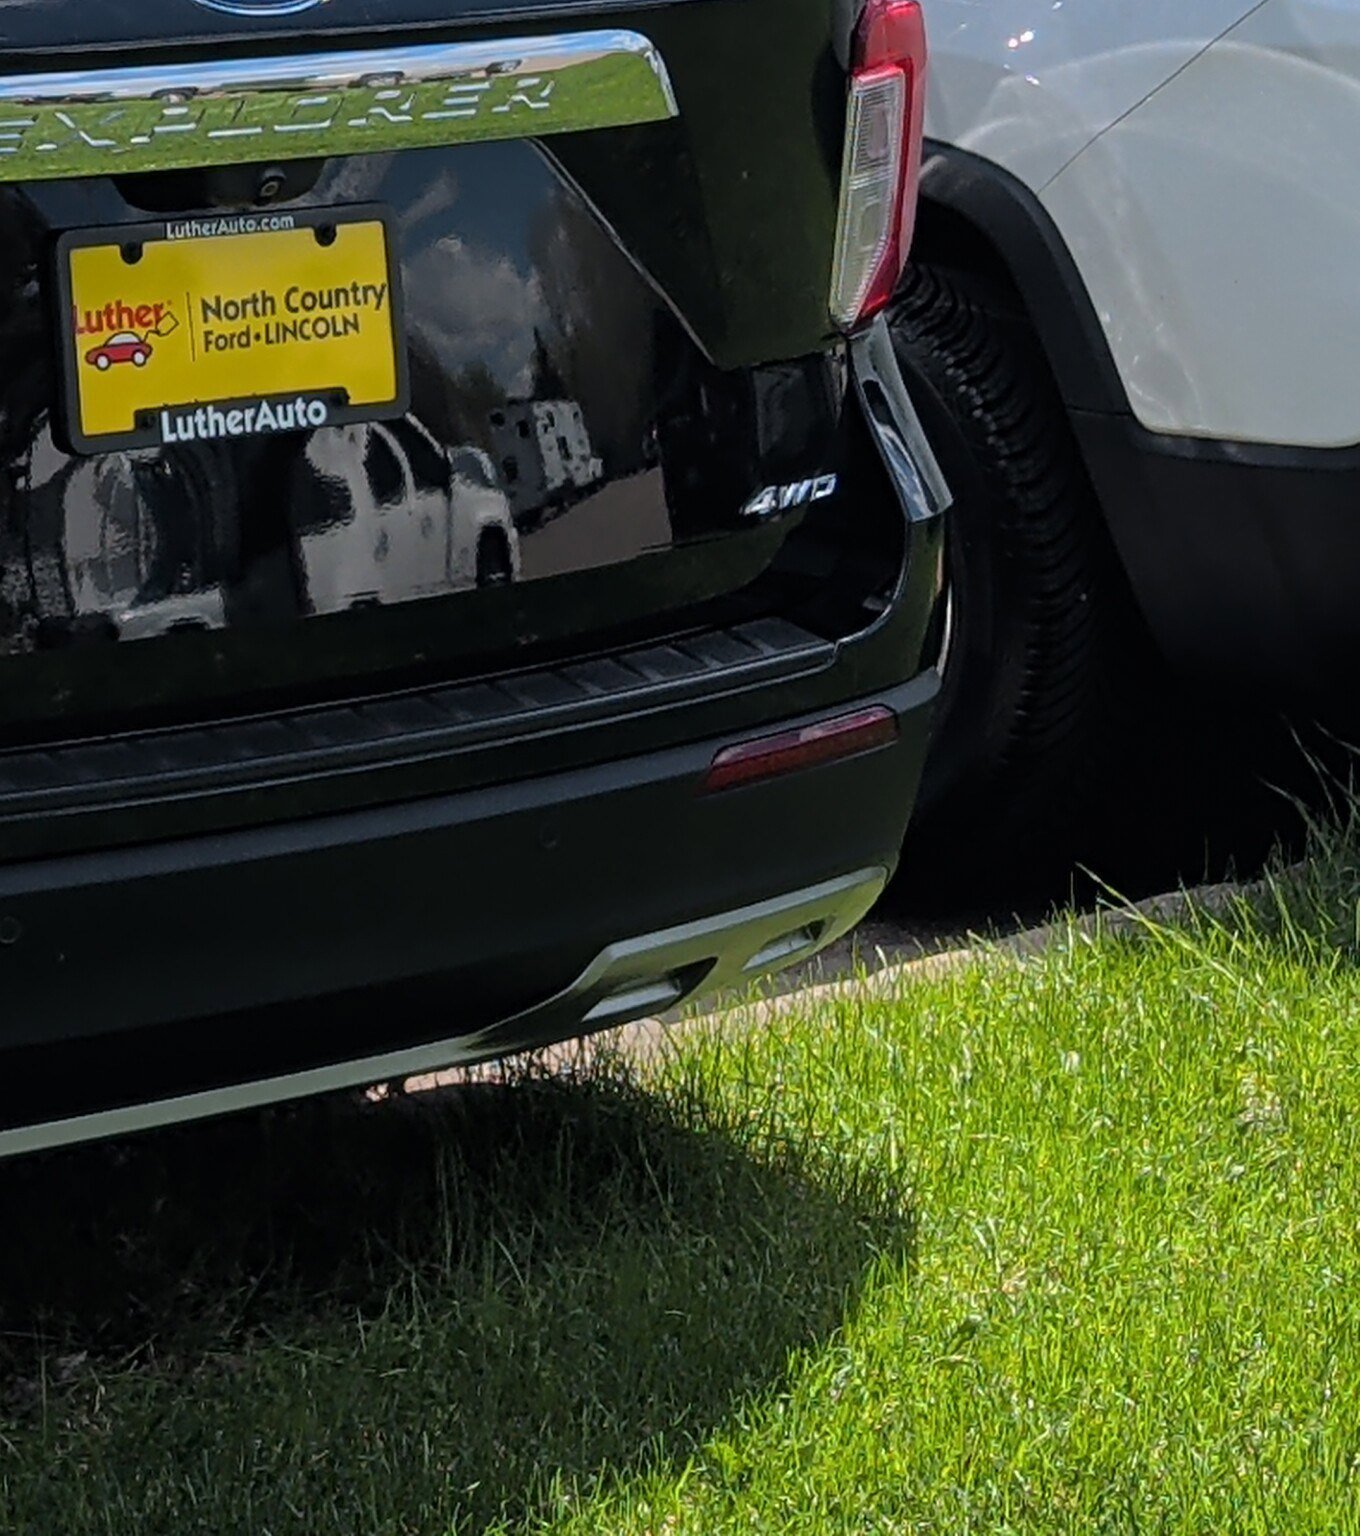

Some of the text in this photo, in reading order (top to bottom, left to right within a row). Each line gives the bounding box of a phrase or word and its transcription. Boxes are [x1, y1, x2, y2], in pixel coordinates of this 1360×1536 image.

[166, 214, 295, 240] LutherAuto.com
[72, 299, 164, 334] Luther
[201, 281, 388, 324] North Country
[161, 396, 328, 443] LutherAuto
[743, 472, 838, 516] 4WD
